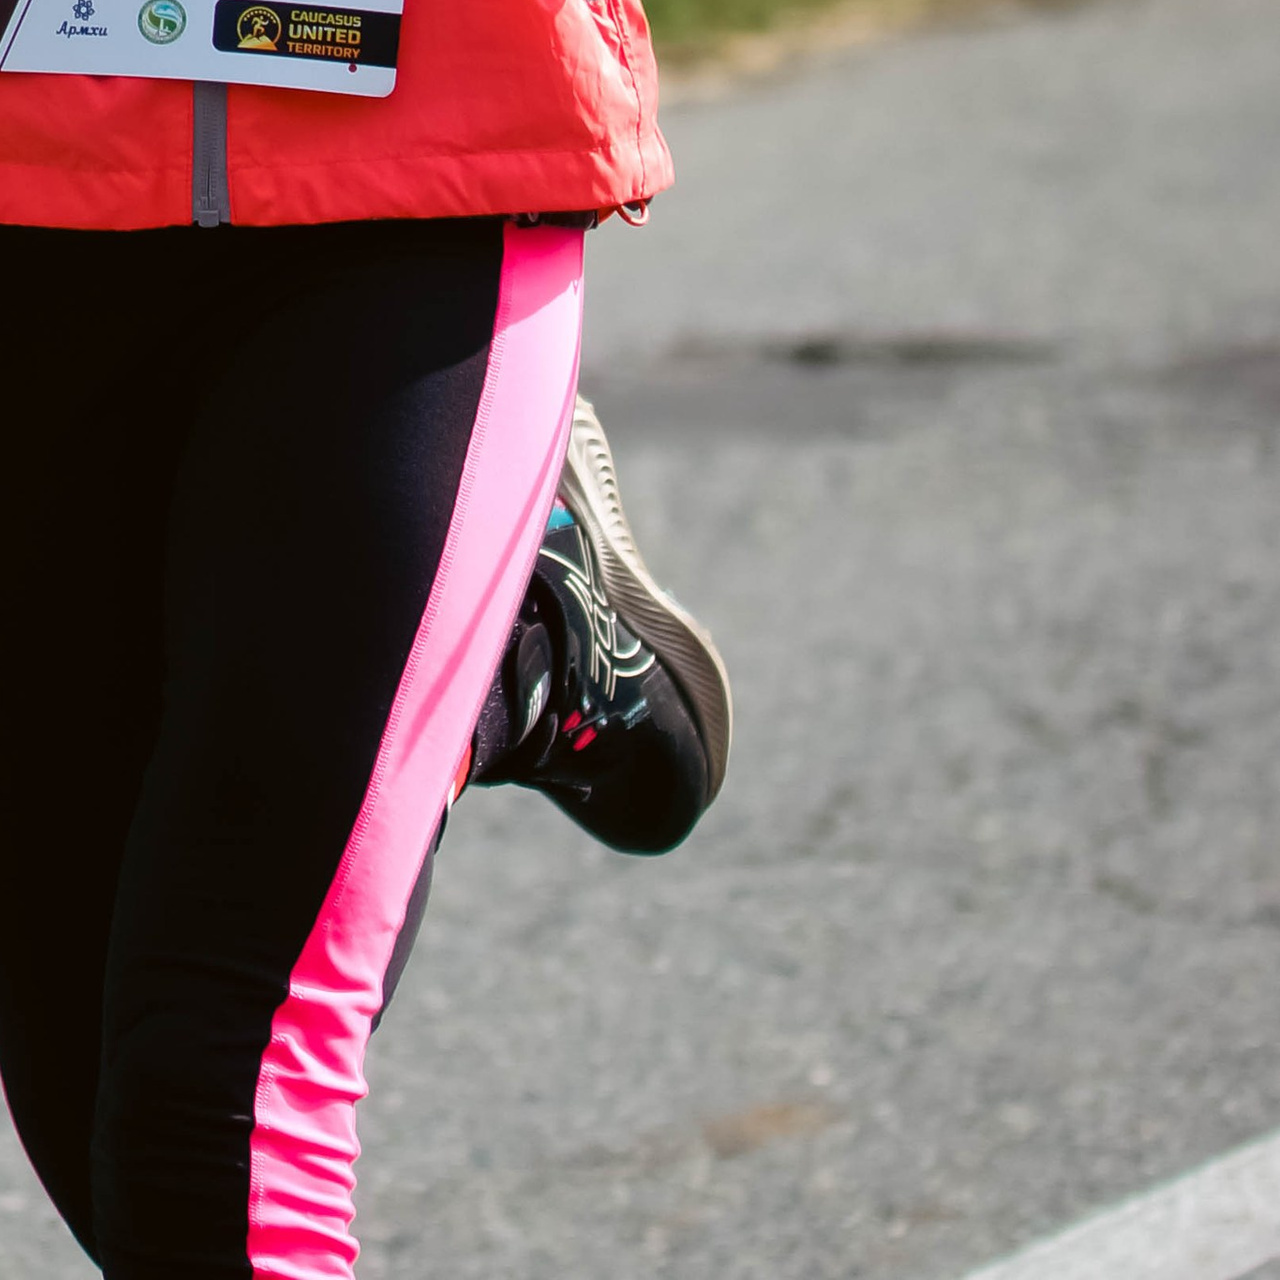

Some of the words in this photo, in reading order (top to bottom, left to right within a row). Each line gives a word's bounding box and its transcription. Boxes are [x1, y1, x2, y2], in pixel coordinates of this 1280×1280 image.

[291, 10, 362, 28] CAUCASUS
[56, 21, 108, 38] Армхи
[289, 23, 362, 45] UNITED
[287, 41, 361, 59] TERRITORY
